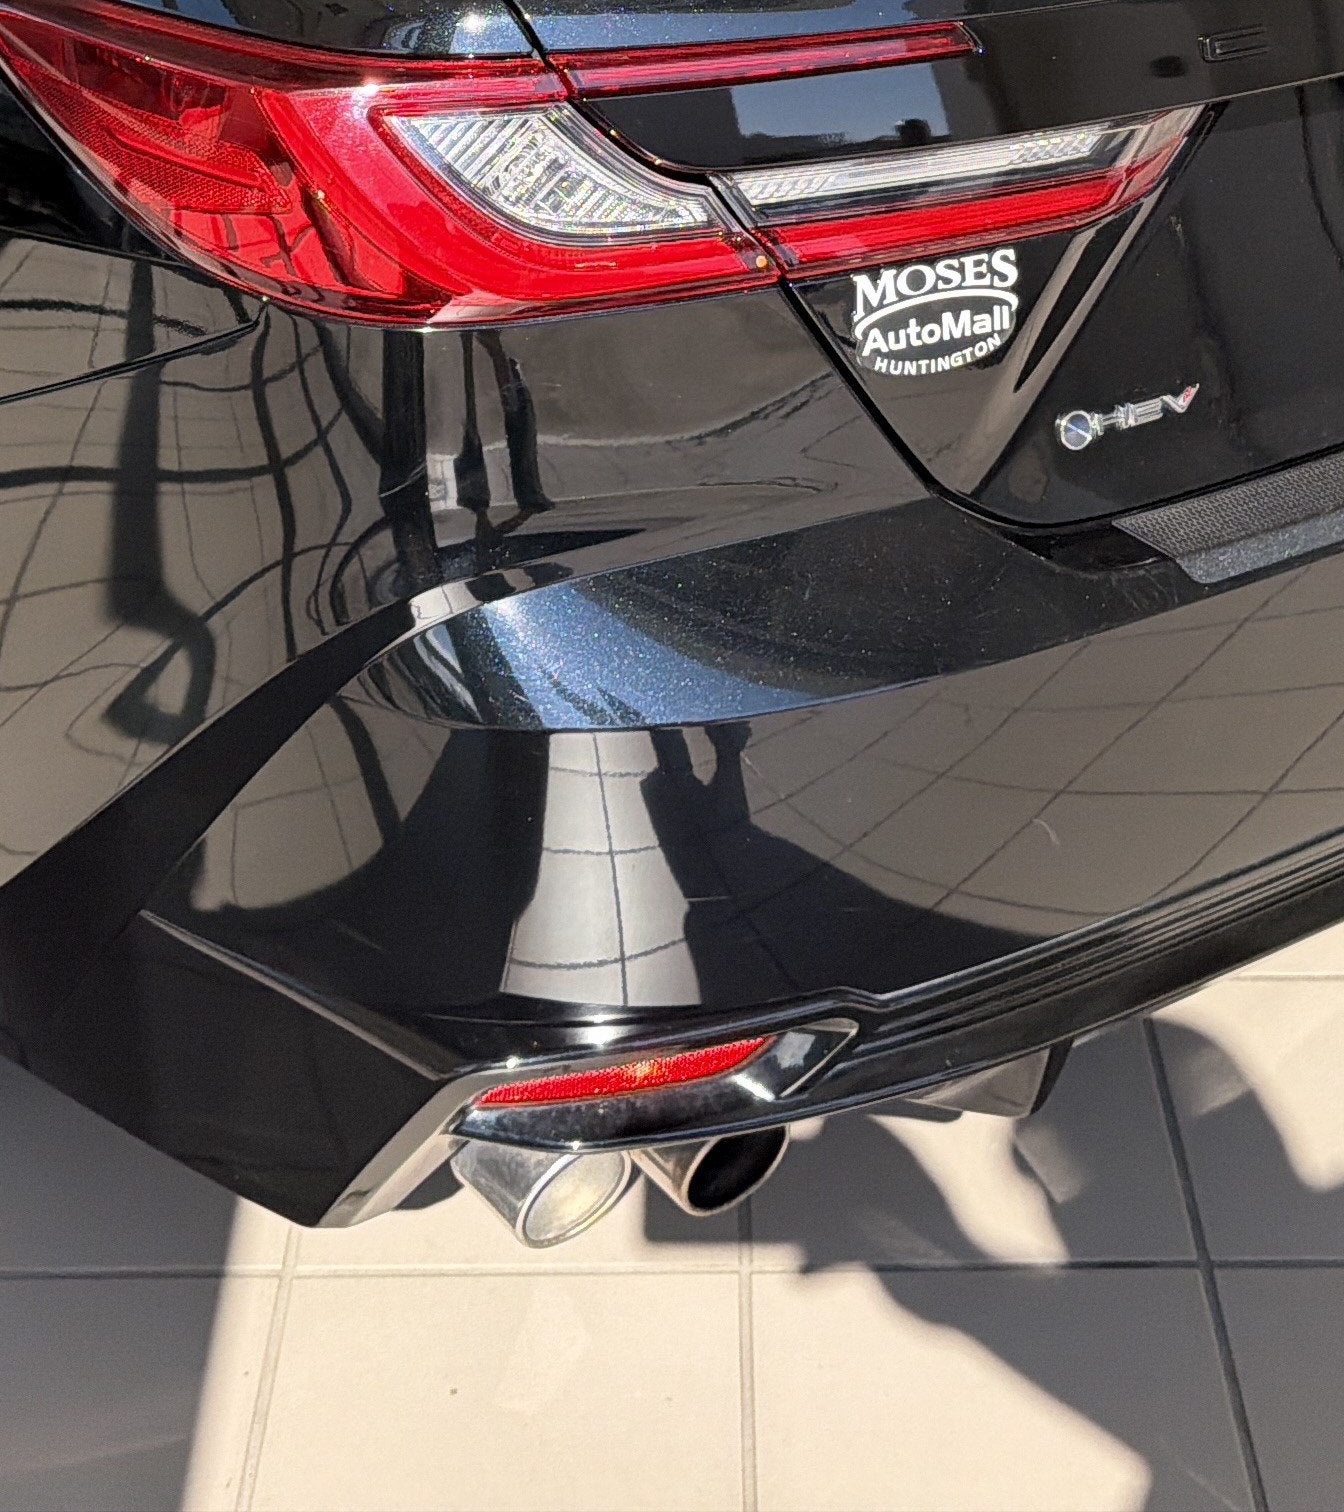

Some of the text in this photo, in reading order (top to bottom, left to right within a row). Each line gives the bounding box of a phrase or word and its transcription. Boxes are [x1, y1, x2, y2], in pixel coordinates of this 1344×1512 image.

[851, 249, 1018, 322] MOSES
[862, 305, 1010, 357] AutoMall
[874, 333, 1002, 376] HUNTINGTON
[1091, 383, 1200, 435] HEV
